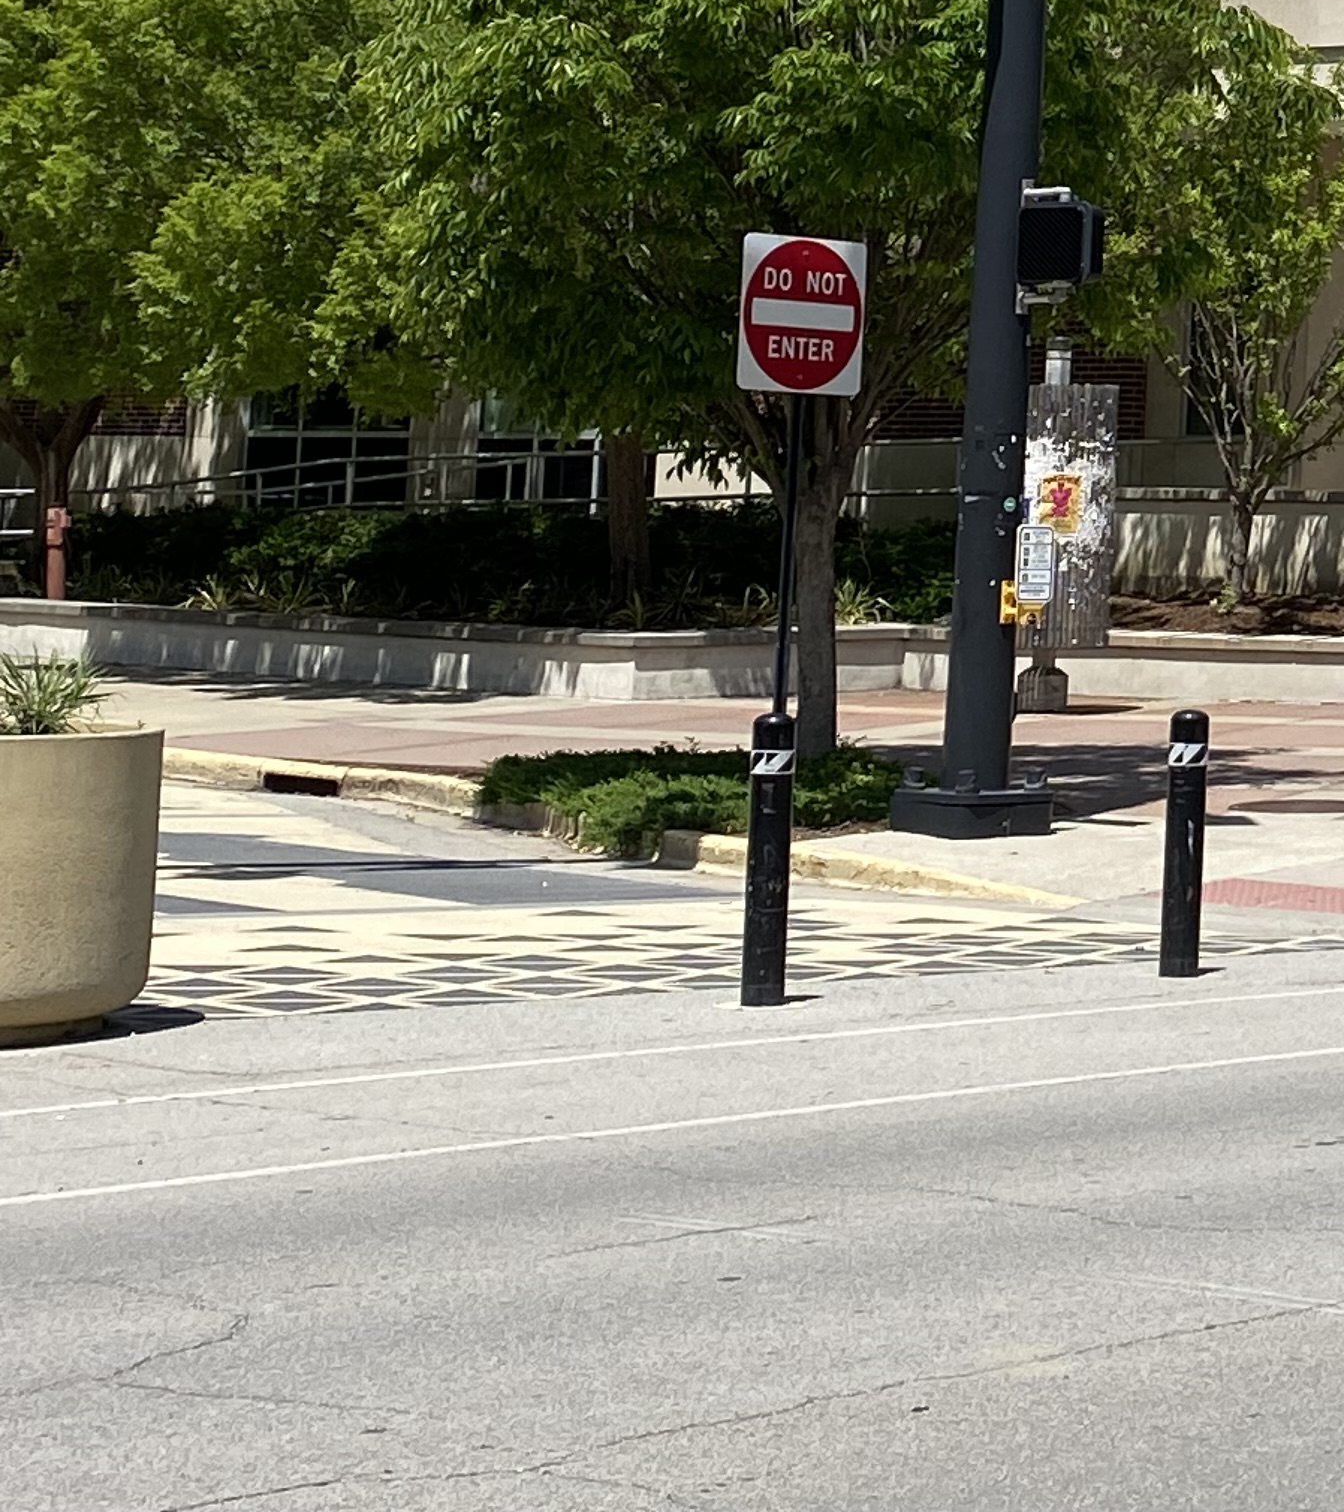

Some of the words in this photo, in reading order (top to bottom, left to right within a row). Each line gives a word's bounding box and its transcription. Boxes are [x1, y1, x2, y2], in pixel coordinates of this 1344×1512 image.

[764, 267, 793, 291] DO
[806, 270, 847, 296] NOT
[768, 335, 834, 362] ENTER
